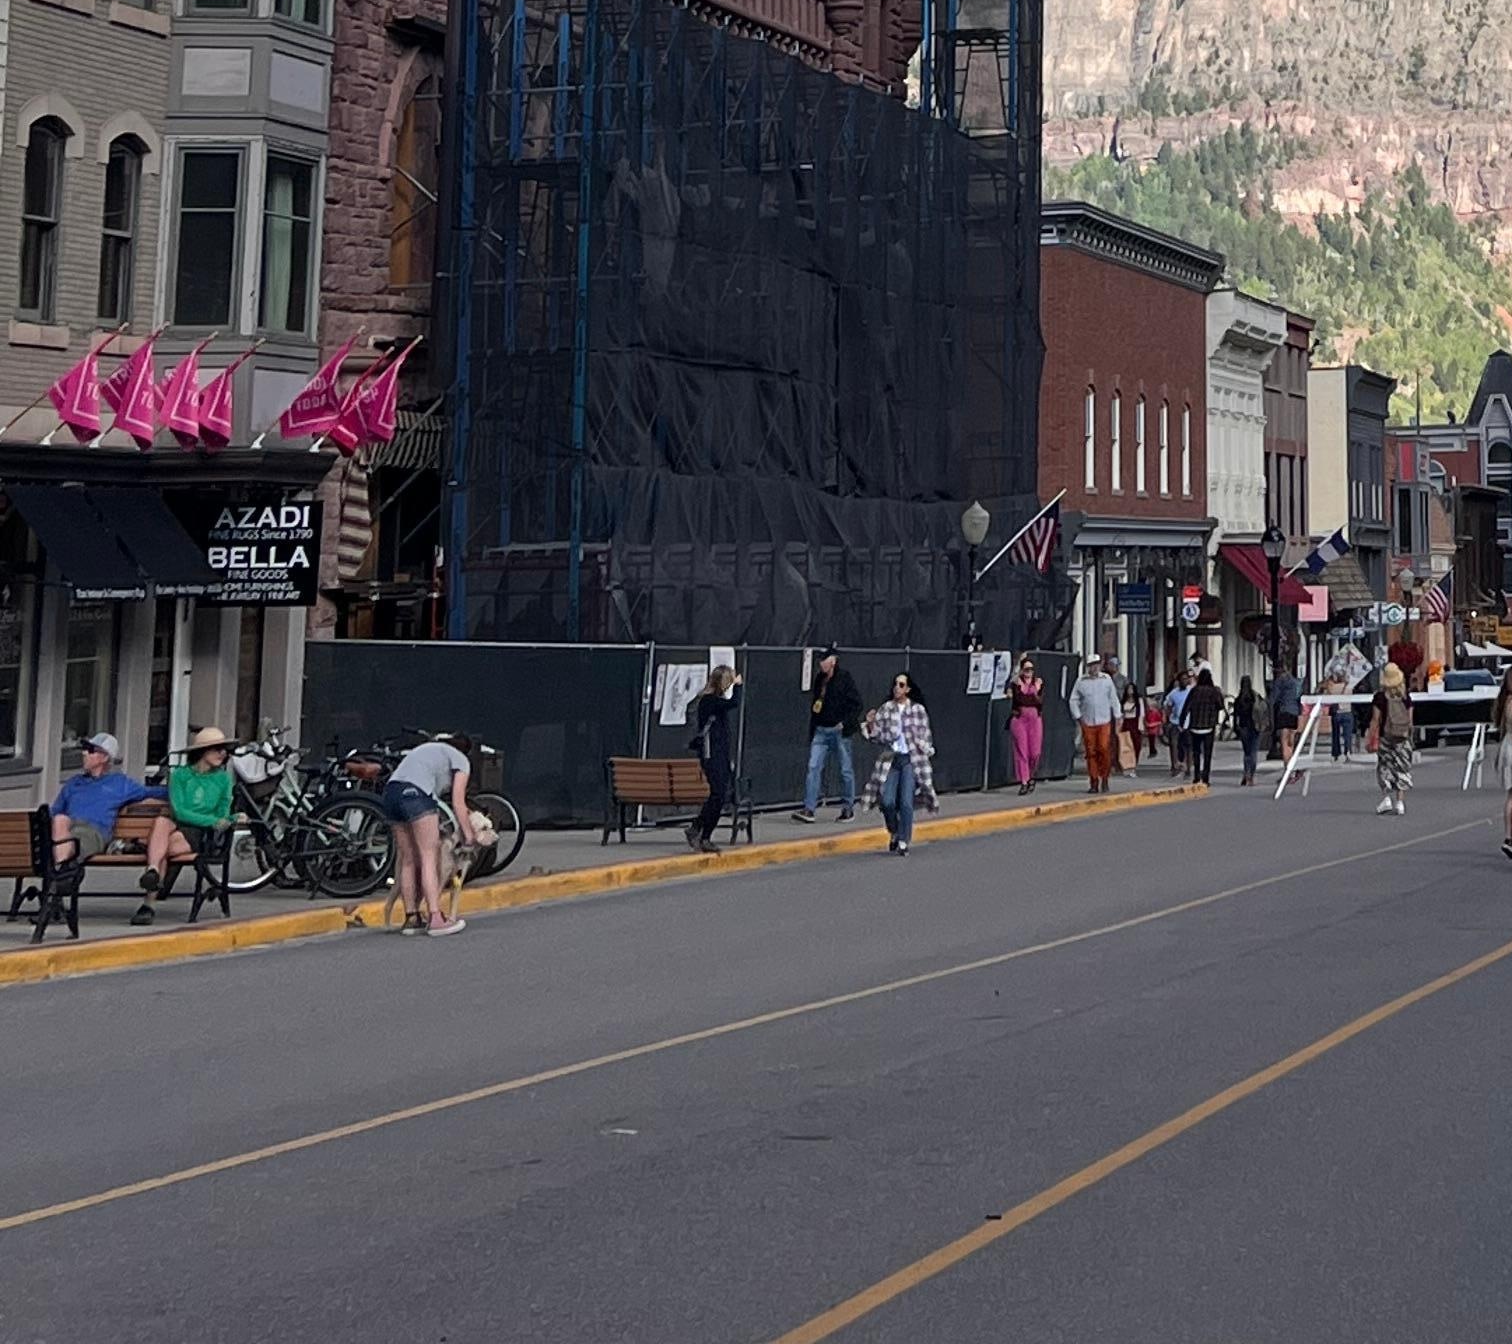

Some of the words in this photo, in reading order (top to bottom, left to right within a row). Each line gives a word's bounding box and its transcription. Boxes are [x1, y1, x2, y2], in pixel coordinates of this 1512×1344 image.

[214, 505, 311, 529] AZADI
[231, 530, 260, 541] RUGS
[261, 529, 288, 540] Since
[207, 546, 310, 569] BELLA
[250, 569, 289, 580] GOODS
